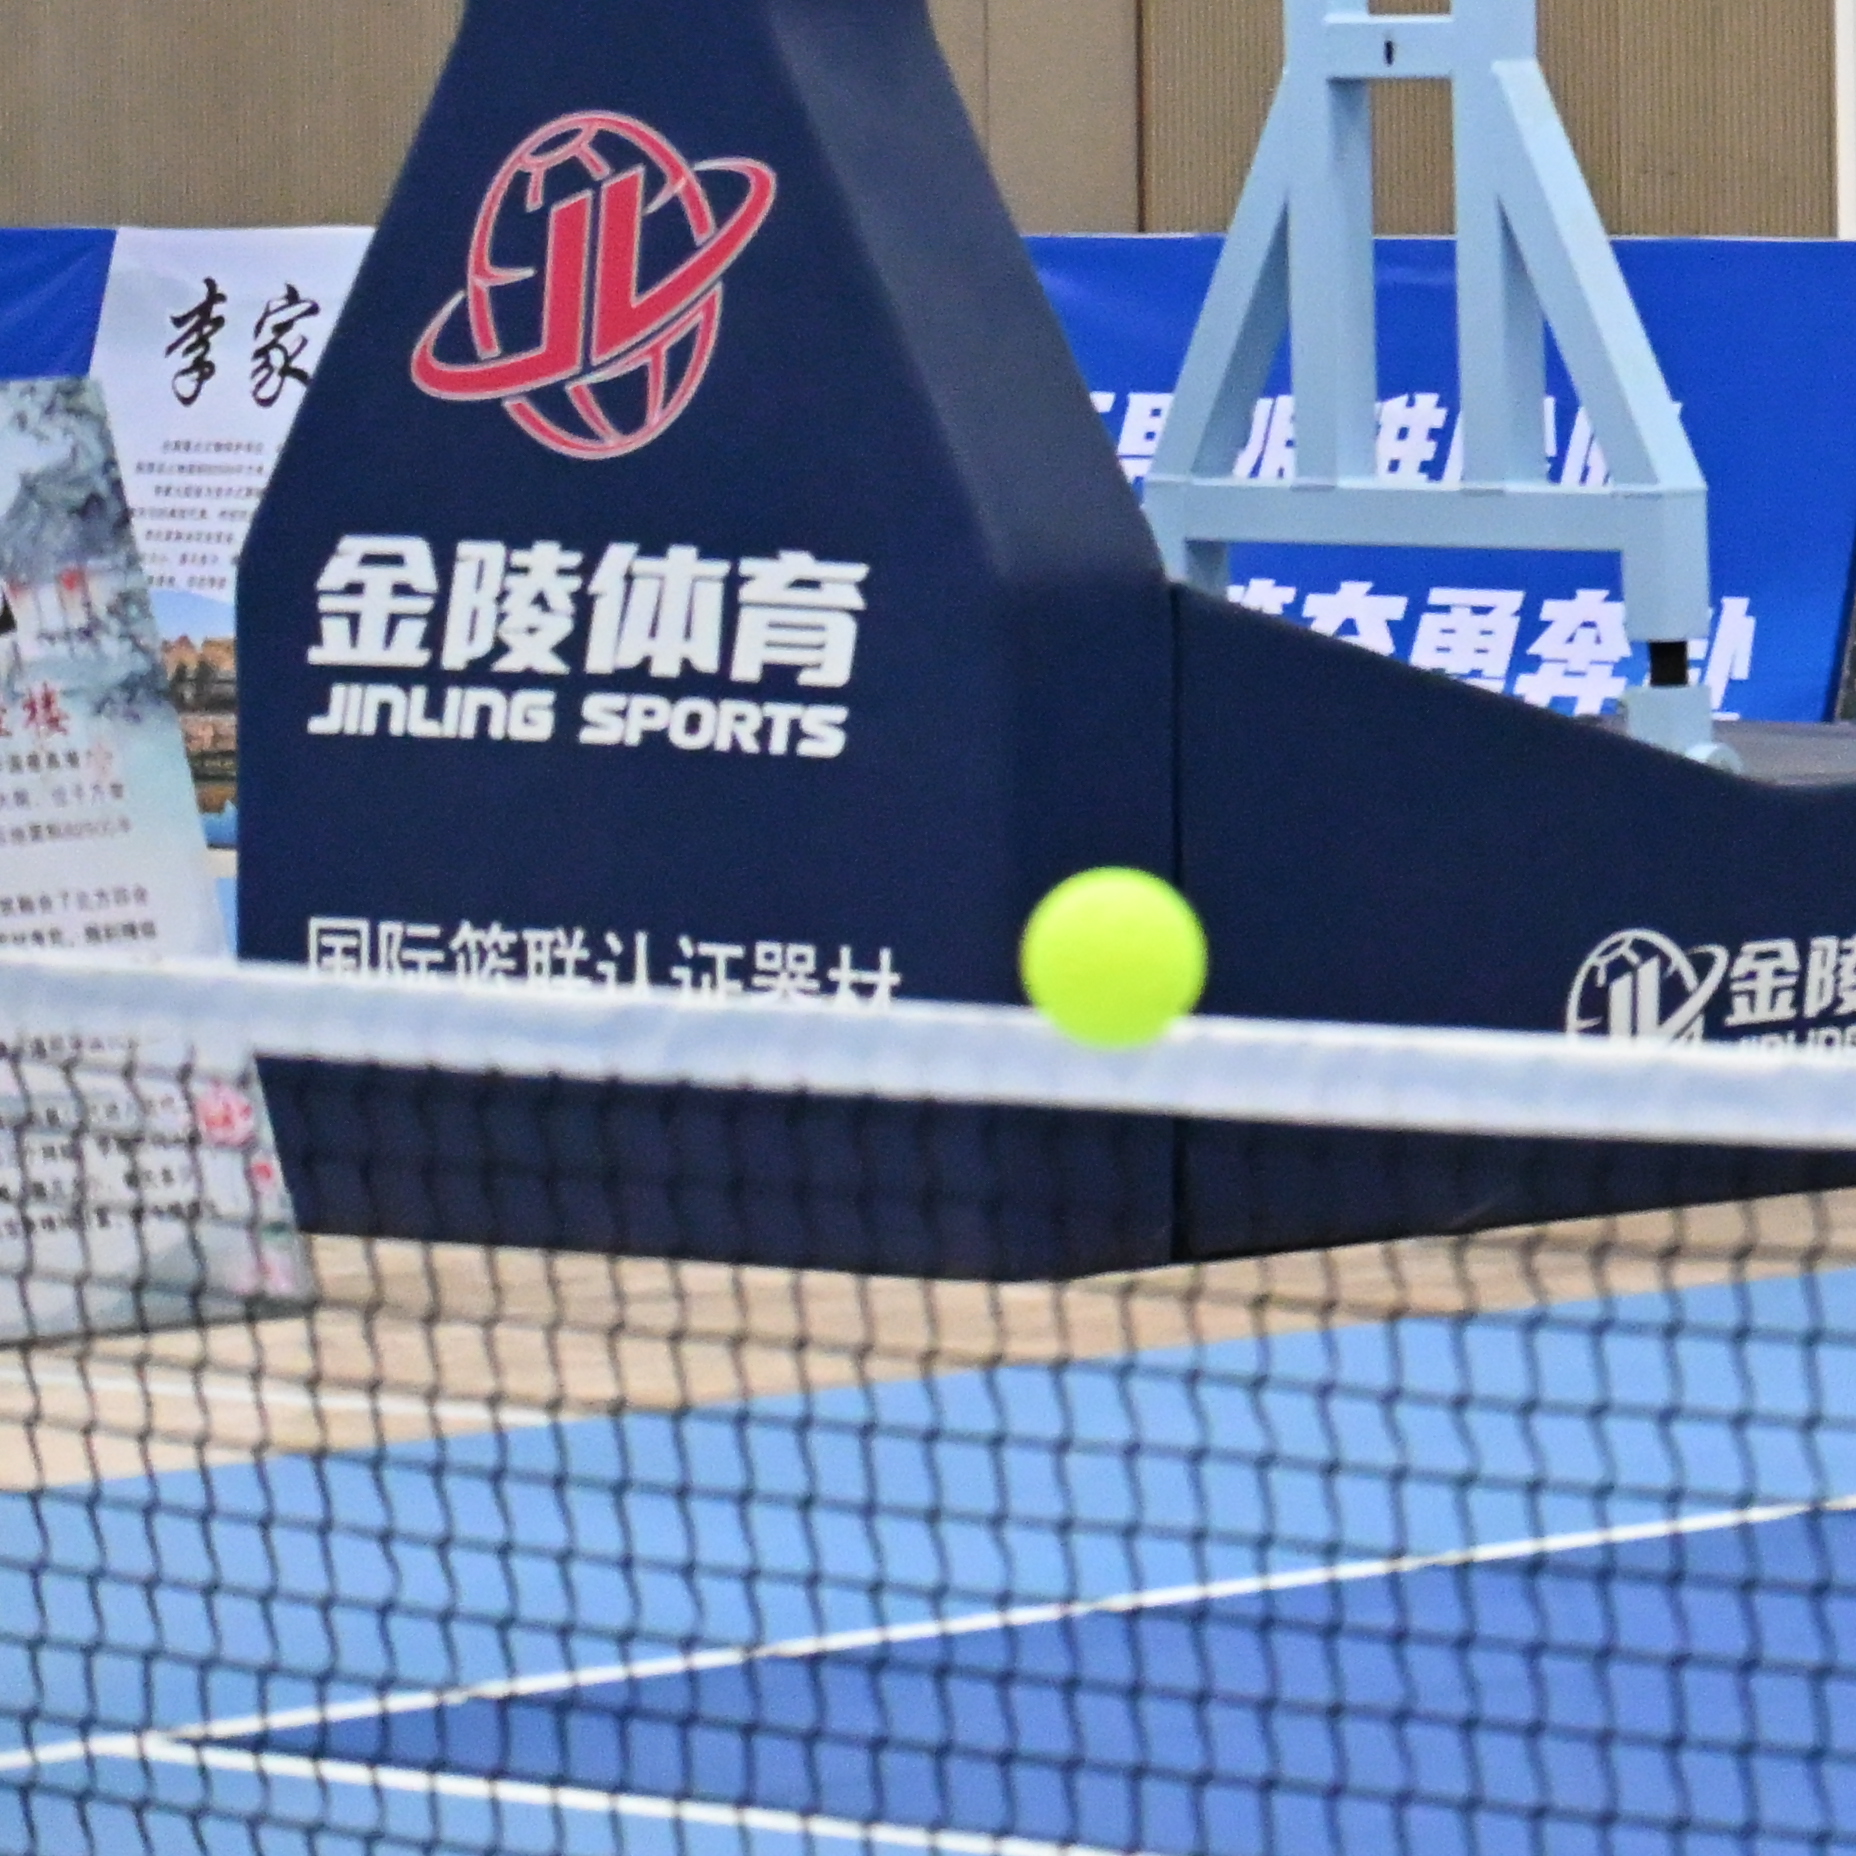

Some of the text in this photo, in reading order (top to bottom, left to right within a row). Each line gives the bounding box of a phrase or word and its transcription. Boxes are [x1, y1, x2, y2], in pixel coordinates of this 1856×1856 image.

[307, 534, 870, 688] 金陵体育
[307, 683, 849, 759] JINLING SPORTS
